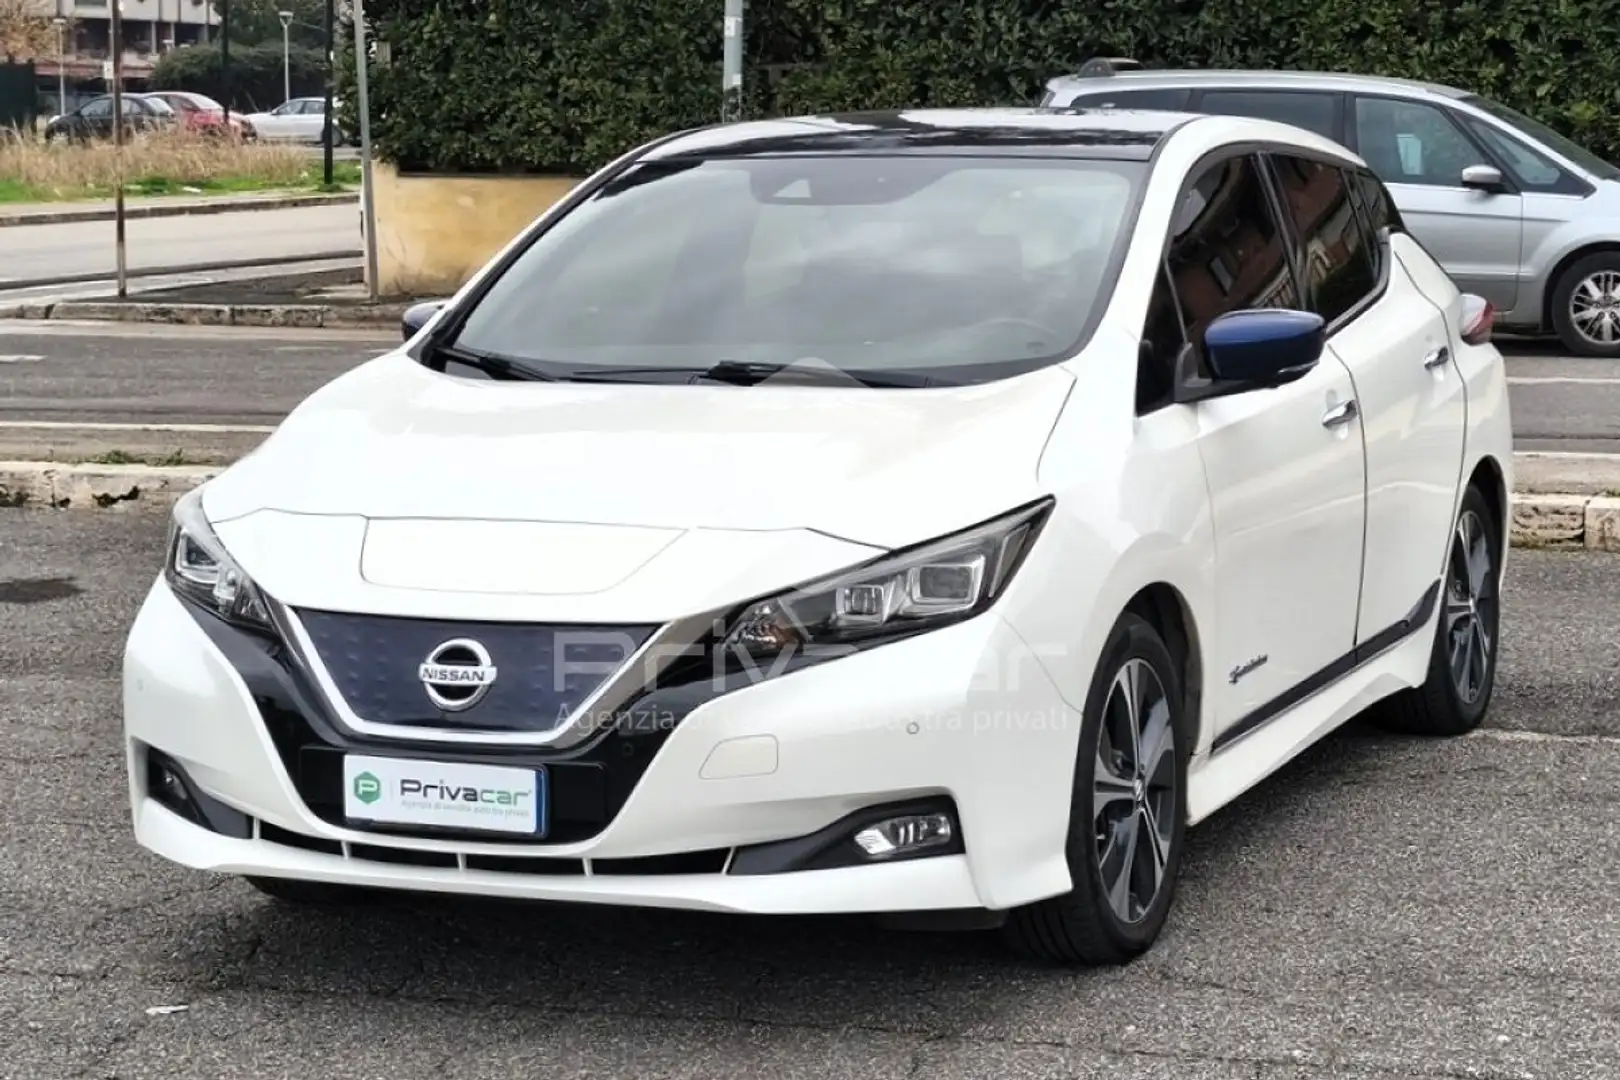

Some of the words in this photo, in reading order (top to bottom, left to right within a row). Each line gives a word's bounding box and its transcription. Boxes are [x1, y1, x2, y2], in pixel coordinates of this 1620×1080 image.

[422, 667, 486, 682] NISSAN
[356, 777, 377, 797] P
[399, 777, 529, 807] Privacar
